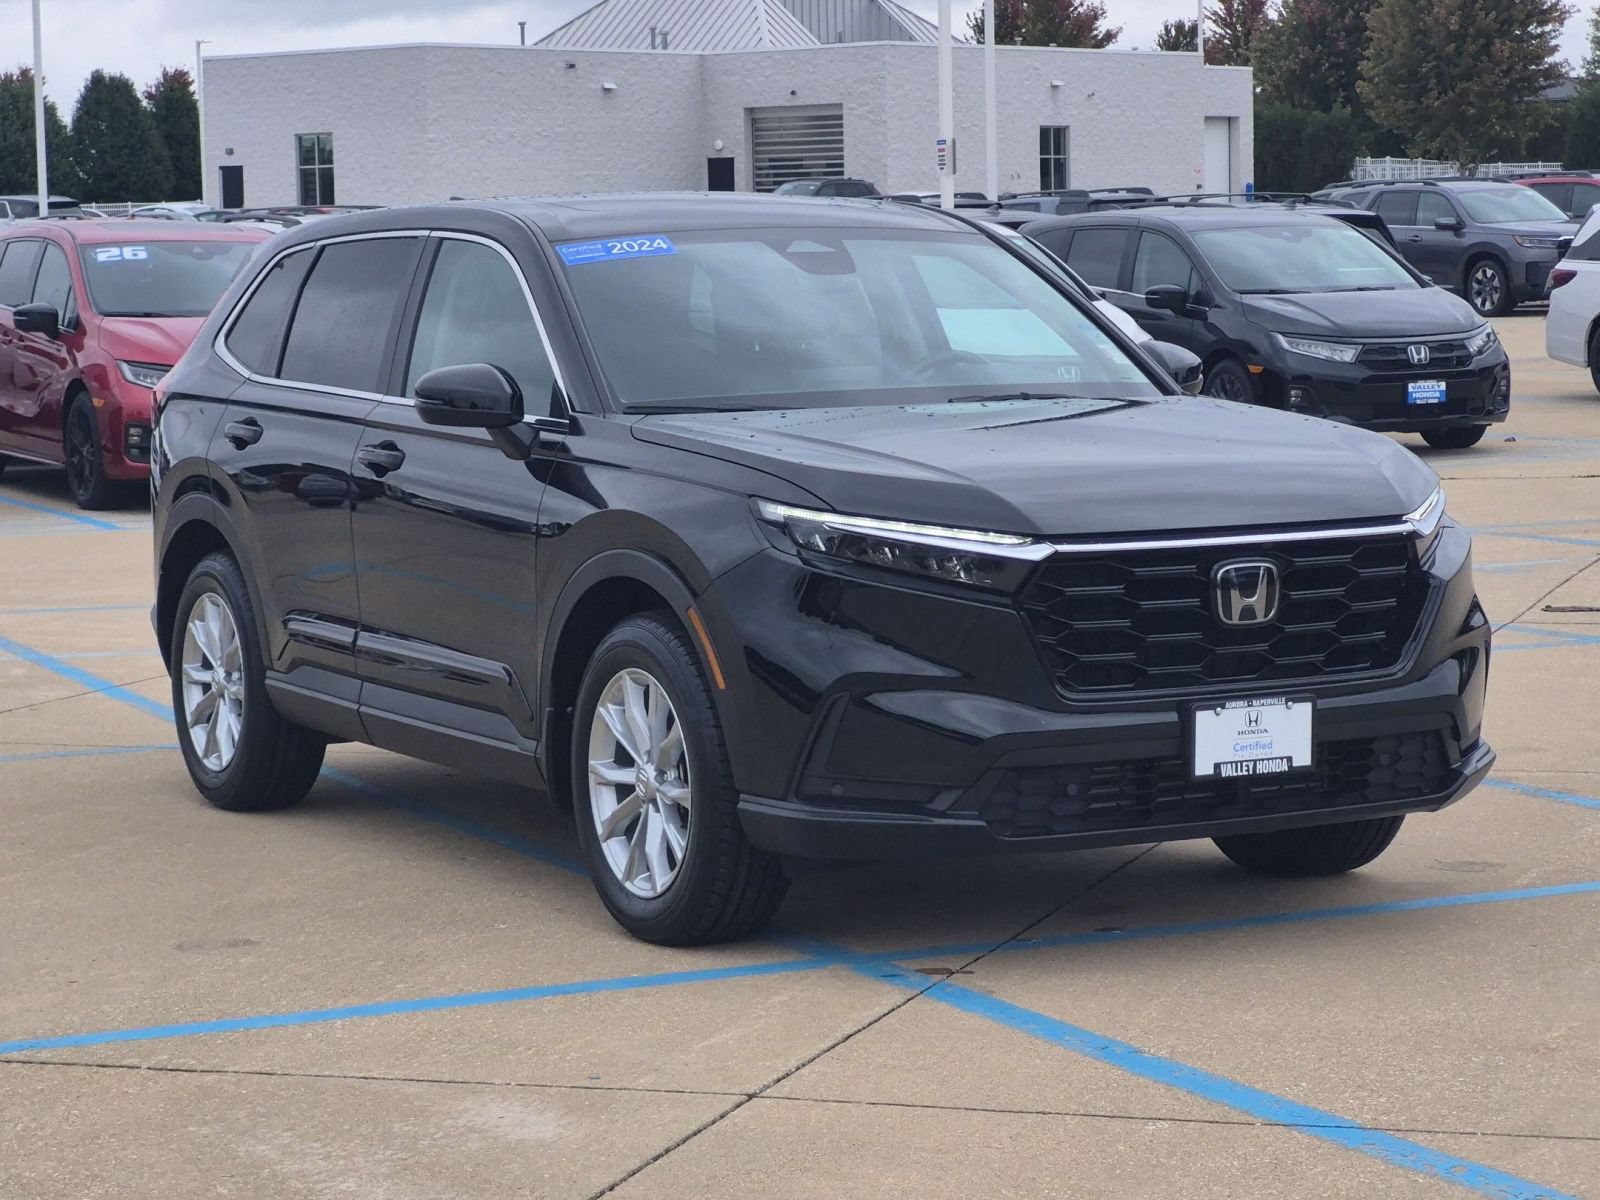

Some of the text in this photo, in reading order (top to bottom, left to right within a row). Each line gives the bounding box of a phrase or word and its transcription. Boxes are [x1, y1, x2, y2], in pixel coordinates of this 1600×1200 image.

[607, 239, 668, 254] 2024
[96, 246, 148, 262] 26
[1411, 383, 1442, 391] VALLEY
[1225, 697, 1286, 709] AURORA NAPERVILLE
[1237, 728, 1269, 736] HONDA
[1233, 740, 1273, 752] Certified
[1220, 758, 1289, 778] VALLEY HONDA
